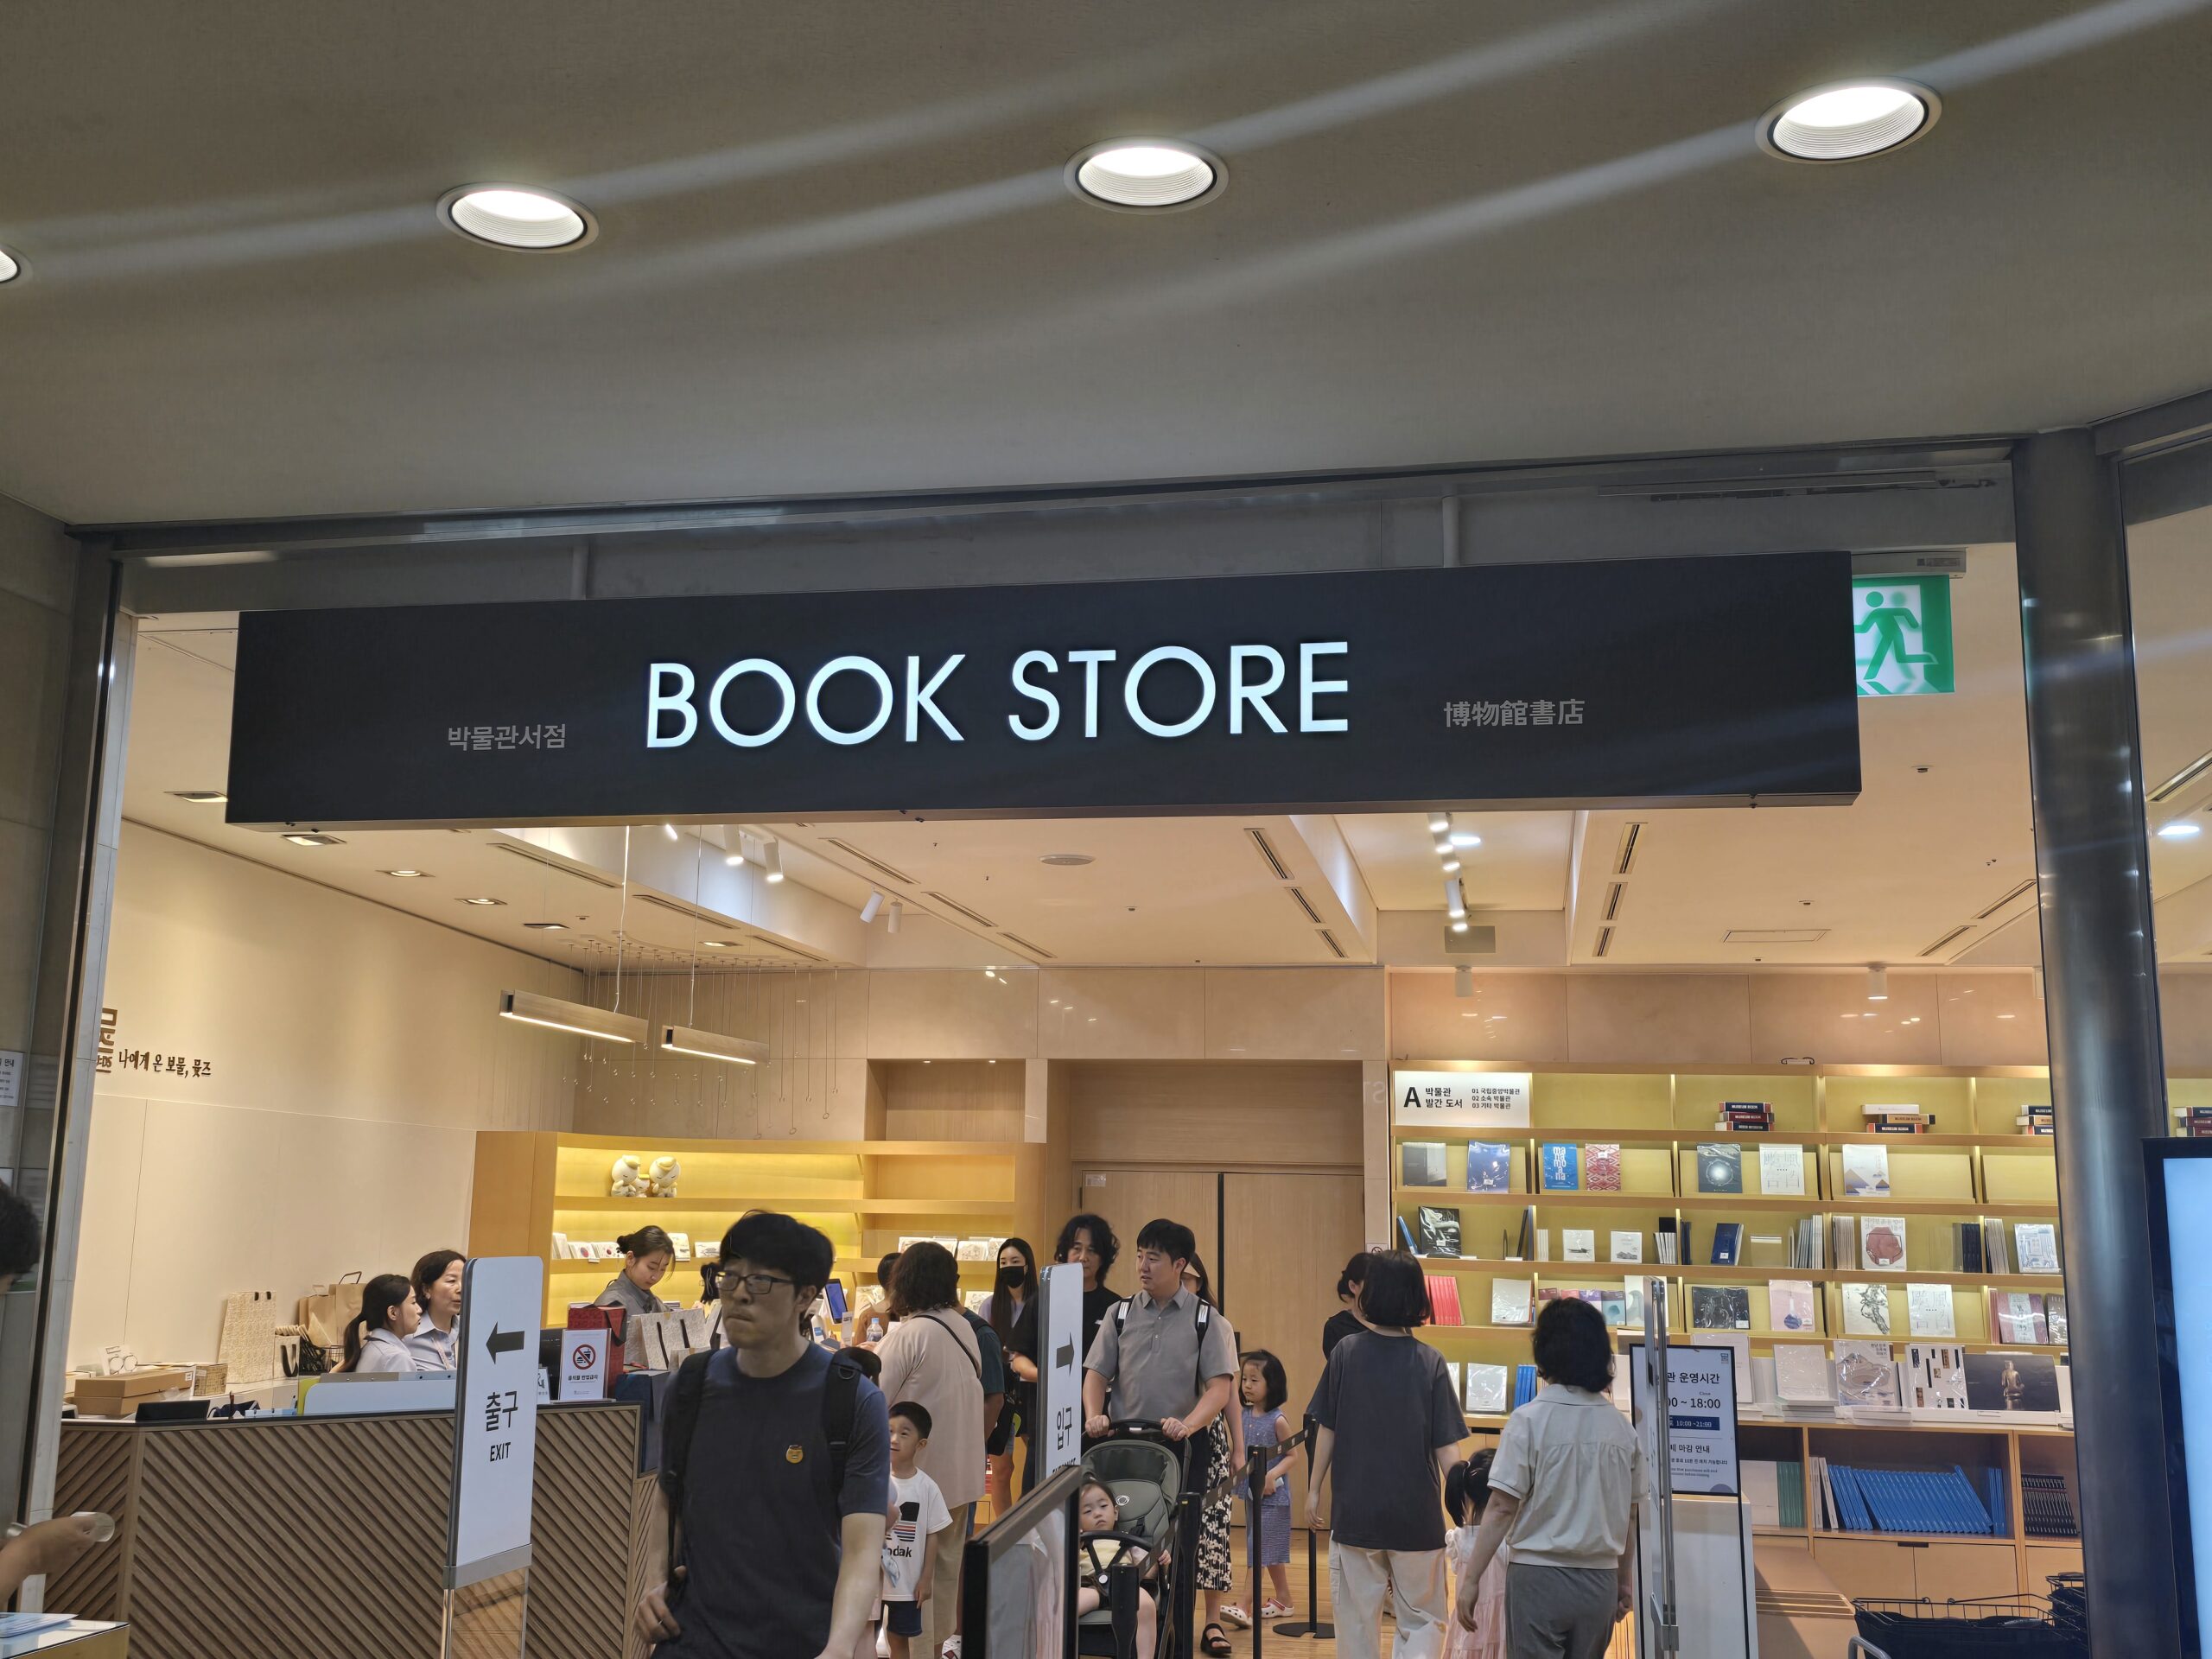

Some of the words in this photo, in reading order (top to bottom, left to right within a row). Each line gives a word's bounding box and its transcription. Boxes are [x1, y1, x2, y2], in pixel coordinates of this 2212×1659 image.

[645, 653, 967, 749] BOOK
[1007, 640, 1349, 741] STORE
[1443, 698, 1586, 728] 博物館書店
[447, 723, 566, 752] 박물관서점
[118, 1048, 149, 1071] 나에게
[152, 1053, 163, 1072] 온
[165, 1056, 188, 1078] 보물,
[1403, 1086, 1421, 1108] A
[1425, 1087, 1452, 1097] 박물관
[1425, 1098, 1443, 1109] 발간
[1445, 1098, 1463, 1109] 도서
[1679, 1372, 1720, 1384] 운영시간
[485, 1390, 518, 1432] 출구
[1690, 1398, 1721, 1409] 18:00
[1056, 1406, 1072, 1451] 입구
[489, 1441, 512, 1462] EXIT
[1678, 1444, 1693, 1453] 마감
[1695, 1445, 1710, 1454] 안내
